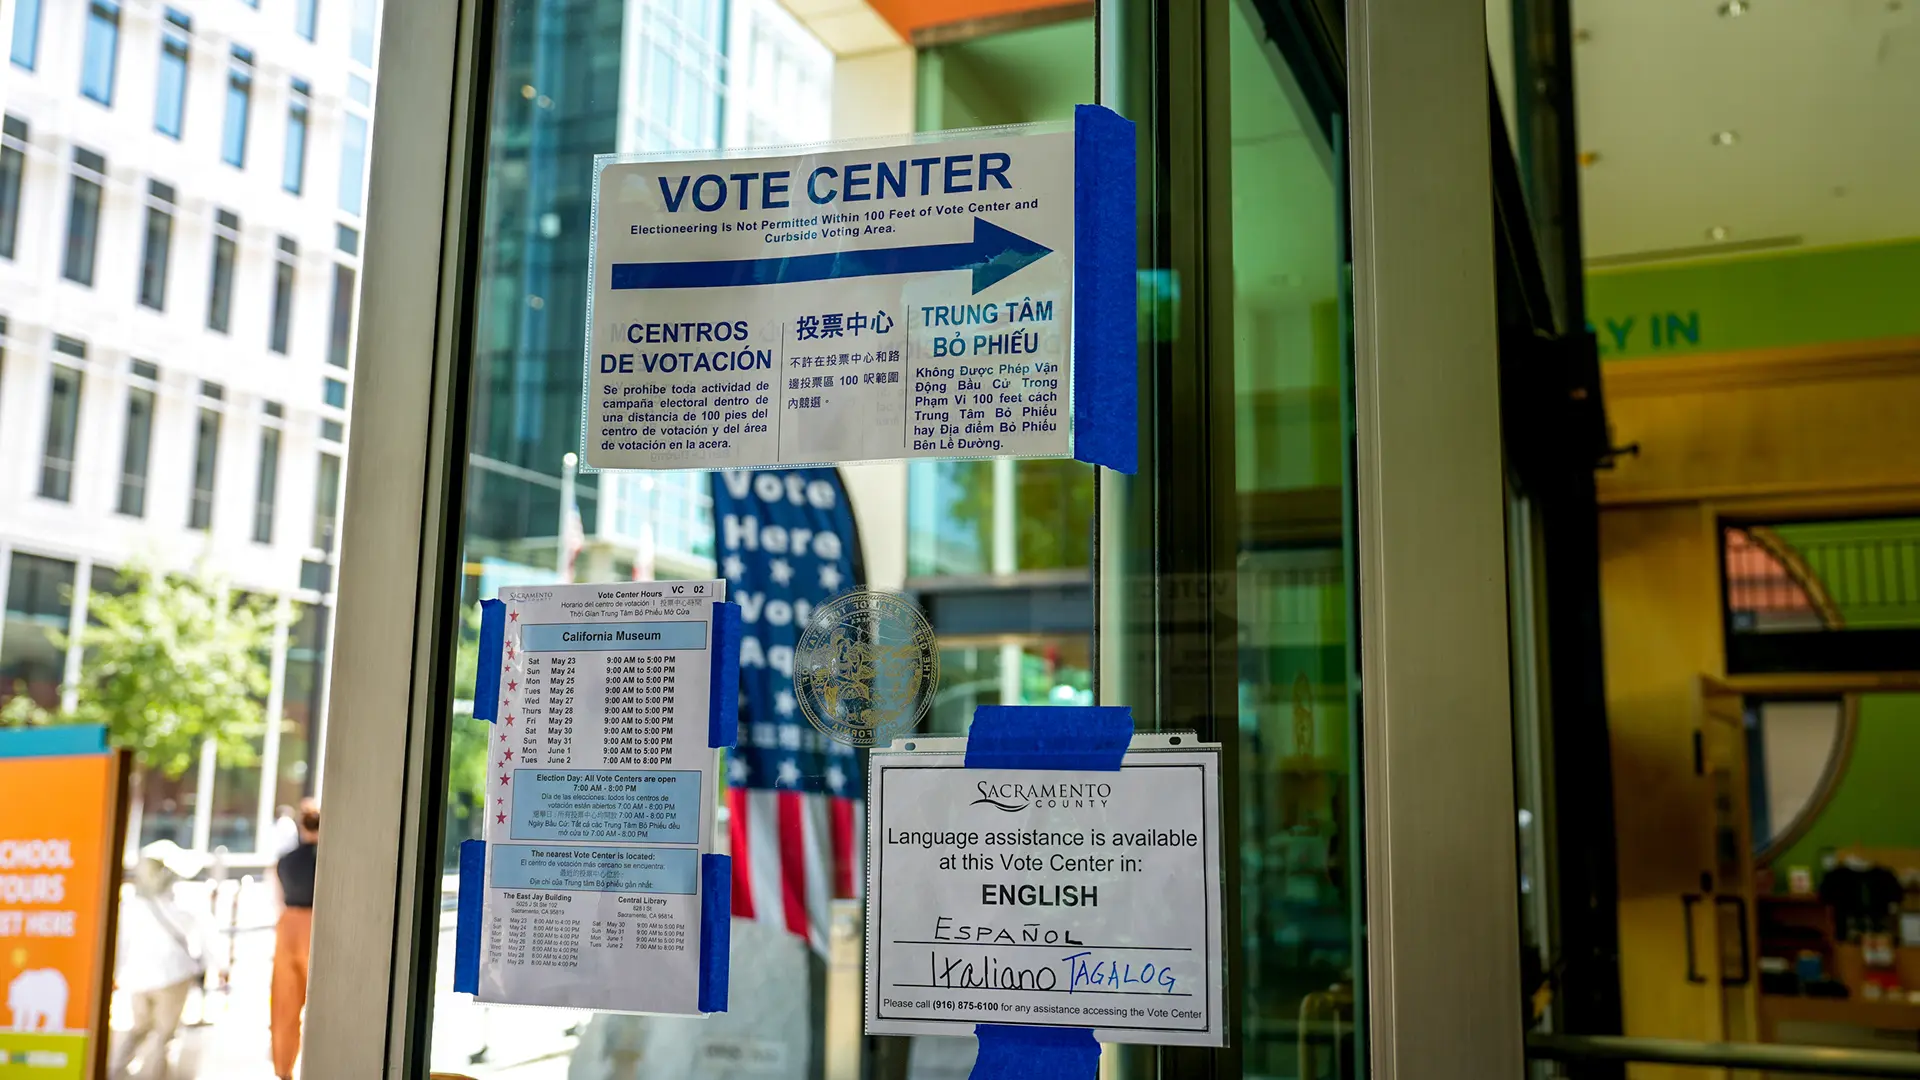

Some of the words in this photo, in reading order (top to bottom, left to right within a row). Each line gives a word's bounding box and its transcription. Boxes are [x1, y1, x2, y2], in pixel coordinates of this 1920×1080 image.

[658, 171, 790, 213] VOTE
[807, 152, 1013, 205] CENTER
[631, 223, 718, 235] Electioneering
[722, 223, 732, 232] Is
[737, 222, 757, 231] Not
[762, 217, 817, 230] Permitted
[822, 212, 859, 224] Within
[864, 211, 885, 221] 100
[890, 209, 915, 219] Feet
[920, 207, 932, 216] of
[936, 205, 964, 215] Vote
[968, 202, 1010, 212] Center
[1015, 199, 1038, 209] and
[765, 232, 817, 243] Curbside
[822, 227, 860, 238] Voting
[864, 225, 896, 234] Area.
[922, 303, 998, 326] TRUNG
[1006, 297, 1053, 322] TÂM
[628, 321, 748, 343] CENTROS
[796, 310, 894, 341] 投票中心
[1651, 310, 1699, 348] IN
[934, 332, 966, 357] BỎ
[974, 328, 1038, 355] PHIẾU
[601, 354, 633, 373] DE
[642, 345, 772, 373] VOTACIÓN
[790, 351, 899, 368] 不許在投票中心和路
[916, 368, 954, 378] Không
[960, 366, 993, 376] Được
[999, 364, 1029, 375] Phép
[1035, 363, 1058, 375] Vận
[604, 385, 618, 395] Se
[672, 384, 696, 393] toda
[702, 382, 750, 393] actividad
[756, 381, 769, 390] de
[789, 376, 834, 389] 邊投票區
[840, 375, 858, 385] 100
[864, 372, 899, 384] 呎範圍
[915, 382, 946, 393] Động
[958, 378, 981, 390] Bầu
[993, 379, 1010, 388] Cử
[1022, 378, 1057, 389] Trong
[603, 400, 653, 410] campaña
[660, 398, 707, 408] electoral
[714, 397, 749, 406] dentro
[756, 395, 768, 404] de
[915, 397, 948, 409] Phạm
[955, 395, 966, 404] Vi
[973, 394, 993, 404] 100
[1000, 393, 1022, 403] feet
[1029, 392, 1057, 402] cách
[603, 413, 622, 422] una
[628, 412, 678, 422] distancia
[683, 412, 696, 421] de
[702, 411, 720, 420] 100
[725, 410, 747, 422] pies
[752, 409, 768, 418] del
[915, 411, 949, 422] Trung
[960, 409, 984, 419] Tâm
[996, 407, 1011, 418] Bỏ
[1022, 404, 1057, 417] Phiếu
[602, 426, 637, 436] centro
[642, 426, 655, 435] de
[661, 425, 707, 435] votación
[712, 426, 718, 436] y
[724, 423, 739, 433] del
[744, 423, 767, 432] área
[914, 426, 934, 437] hay
[940, 425, 959, 437] Địa
[965, 421, 994, 433] điểm
[1000, 422, 1016, 432] Bỏ
[1022, 419, 1056, 431] Phiếu
[601, 441, 615, 450] de
[619, 439, 666, 450] votación
[670, 441, 682, 449] en
[686, 439, 695, 449] la
[699, 440, 731, 448] acera.
[914, 440, 935, 450] Bên
[940, 437, 954, 449] Lề
[958, 438, 1003, 450] Đường.
[721, 470, 836, 509] Vote
[723, 513, 841, 560] Here
[672, 586, 684, 594] VC
[733, 589, 815, 629] Vot
[563, 631, 612, 642] California
[616, 631, 661, 640] Museum
[552, 658, 566, 666] May
[567, 775, 582, 783] Day:
[977, 781, 1111, 801] SACRAMENTO
[1036, 800, 1108, 808] COUNTY
[889, 828, 978, 849] Language
[985, 829, 1084, 846] assistance
[1091, 829, 1105, 845] is
[1112, 829, 1197, 846] available
[0, 839, 74, 868] CHOOL
[532, 851, 545, 859] The
[547, 851, 572, 859] nearest
[626, 853, 655, 861] located:
[940, 854, 956, 870] at
[962, 854, 993, 870] this
[1000, 854, 1043, 871] Vote
[1051, 854, 1114, 871] Center
[1121, 855, 1142, 872] in:
[644, 897, 667, 906] Library
[982, 884, 1098, 907] ENGLISH
[932, 951, 1056, 990] Italiano
[1062, 952, 1176, 994] TAGALOG
[884, 999, 913, 1008] Please
[916, 1000, 930, 1008] call
[933, 1001, 955, 1011] (916)
[958, 1002, 998, 1010] 875-6100
[1001, 1003, 1012, 1011] for
[1015, 1005, 1031, 1014] any
[1034, 1004, 1080, 1014] assistance
[1083, 1006, 1127, 1017] accessing
[1130, 1008, 1144, 1016] the
[1147, 1008, 1168, 1017] Vote
[1171, 1009, 1201, 1018] Center
